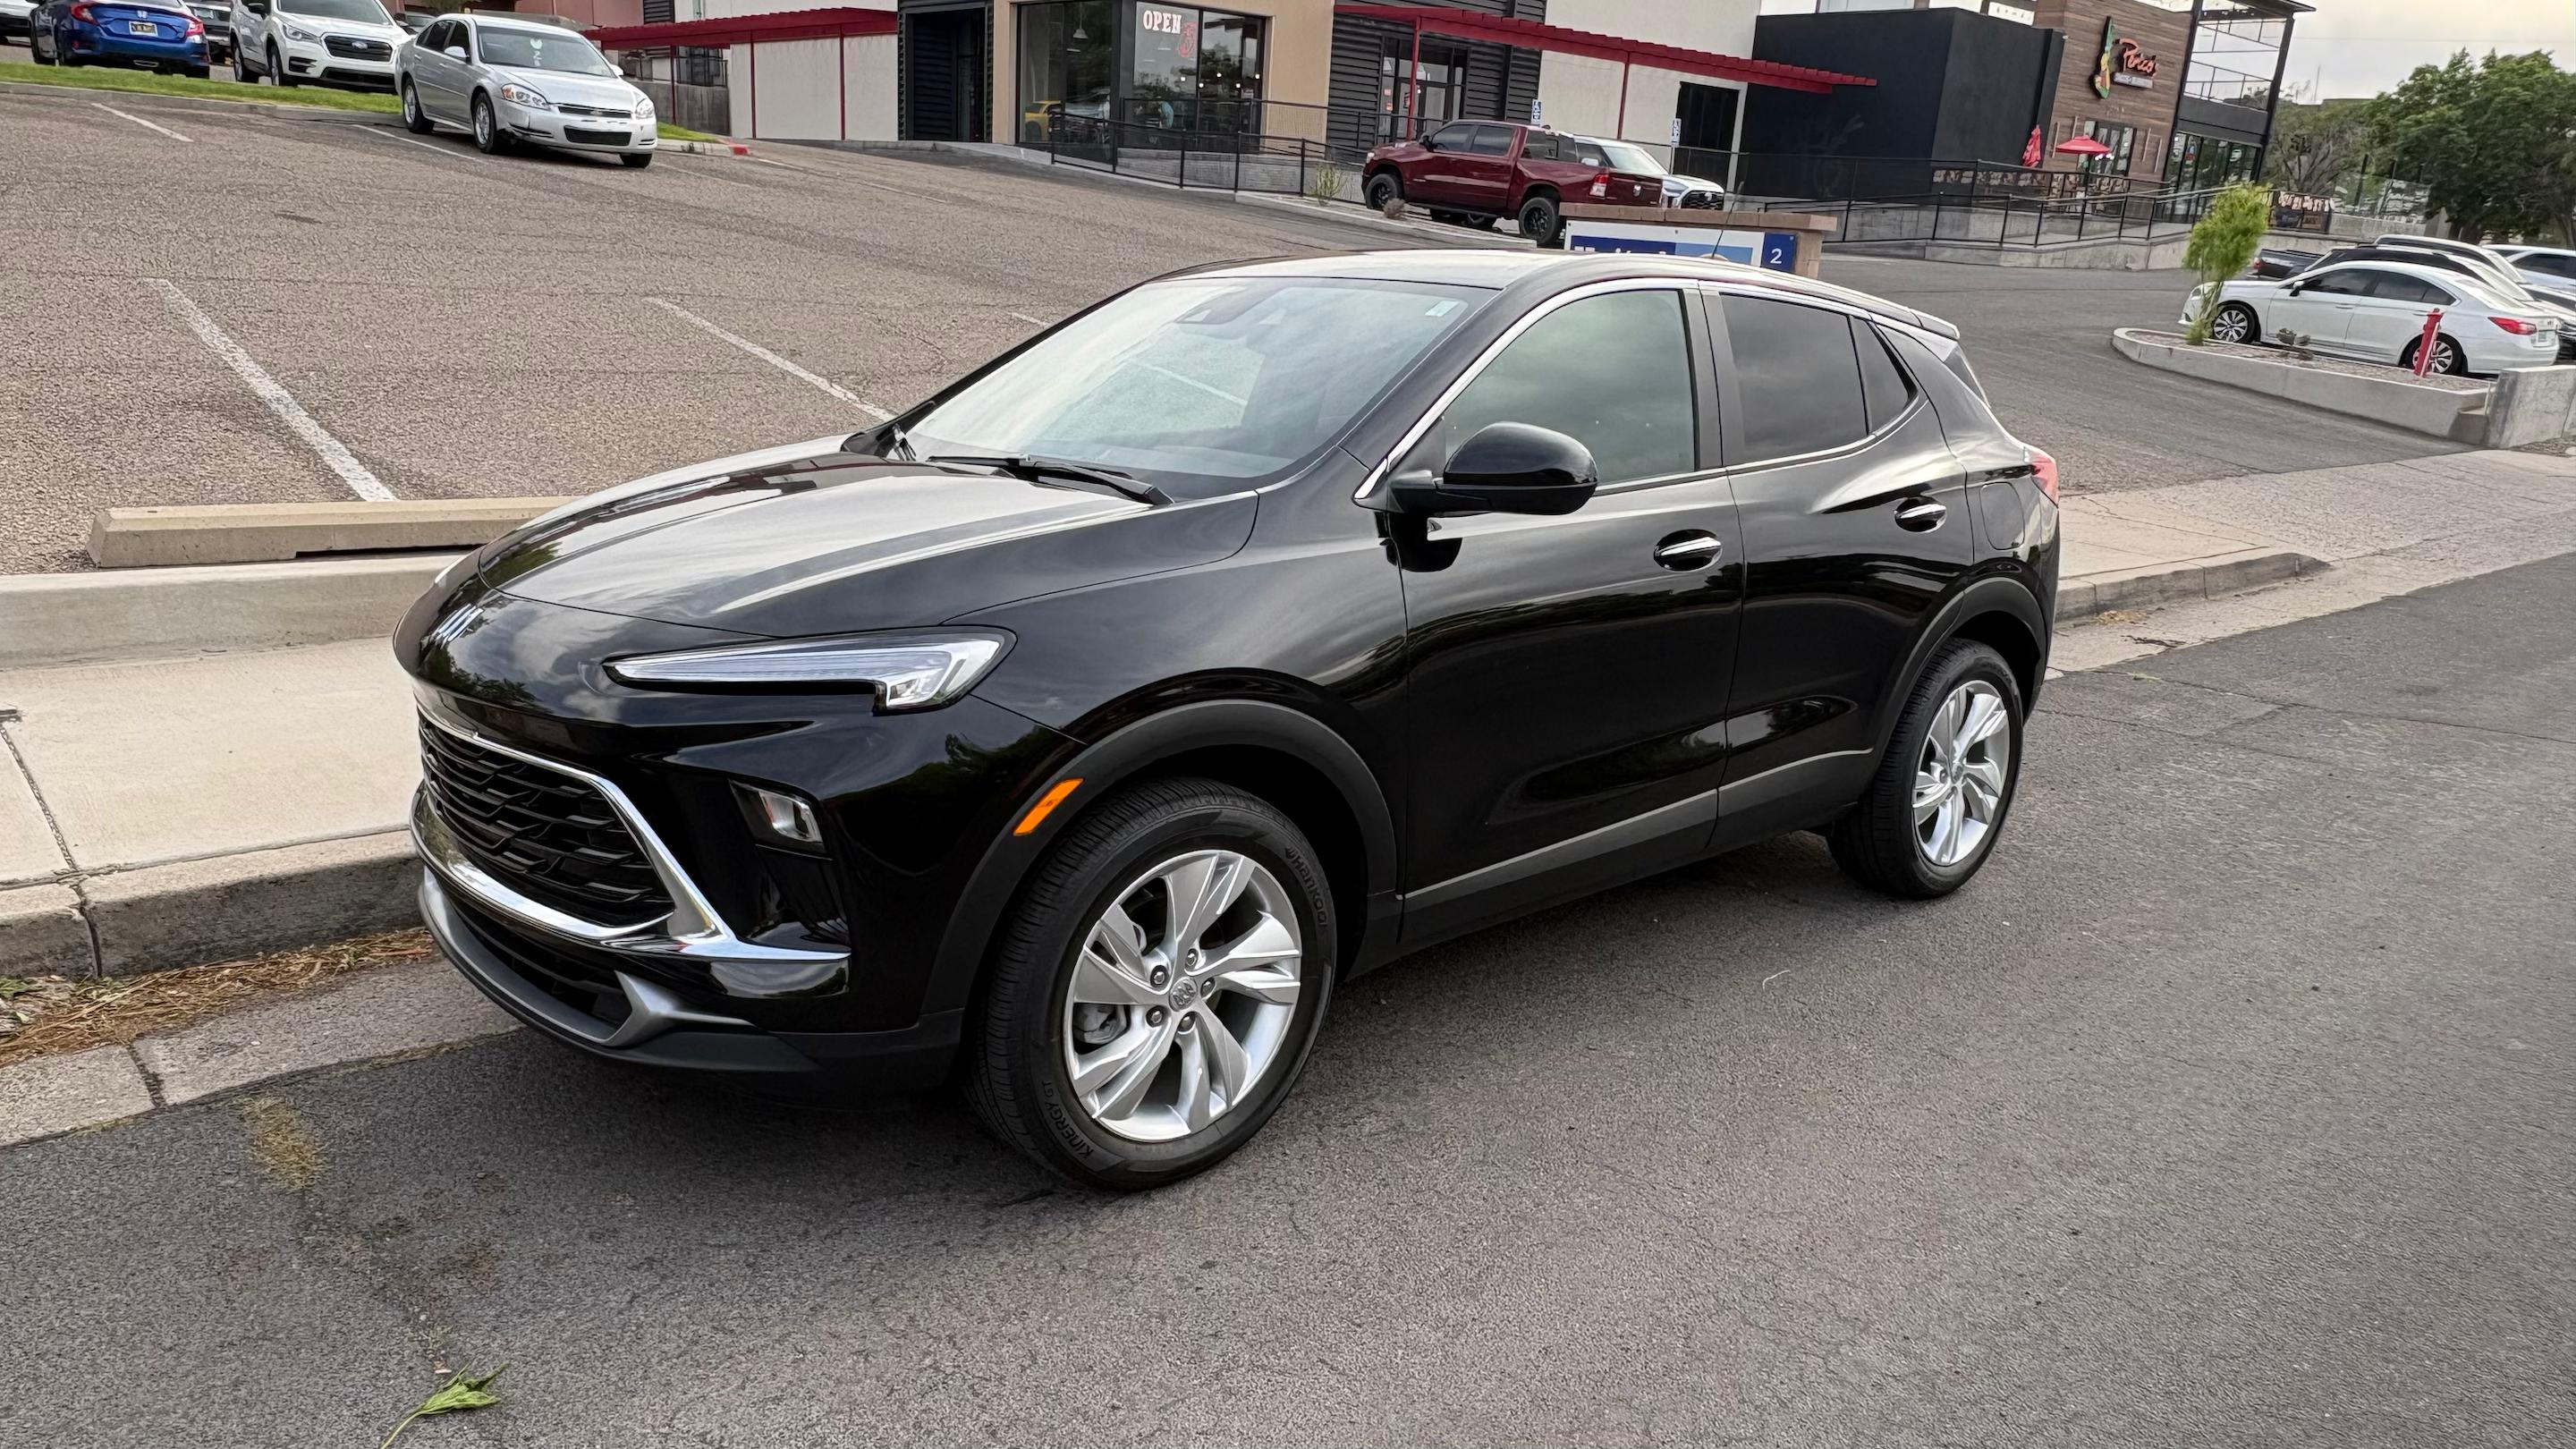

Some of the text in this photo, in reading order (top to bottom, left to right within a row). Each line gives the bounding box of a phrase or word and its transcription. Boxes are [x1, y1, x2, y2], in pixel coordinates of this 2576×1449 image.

[1143, 10, 1182, 35] OPEN
[1770, 248, 1782, 264] 2
[1042, 1081, 1054, 1097] GT
